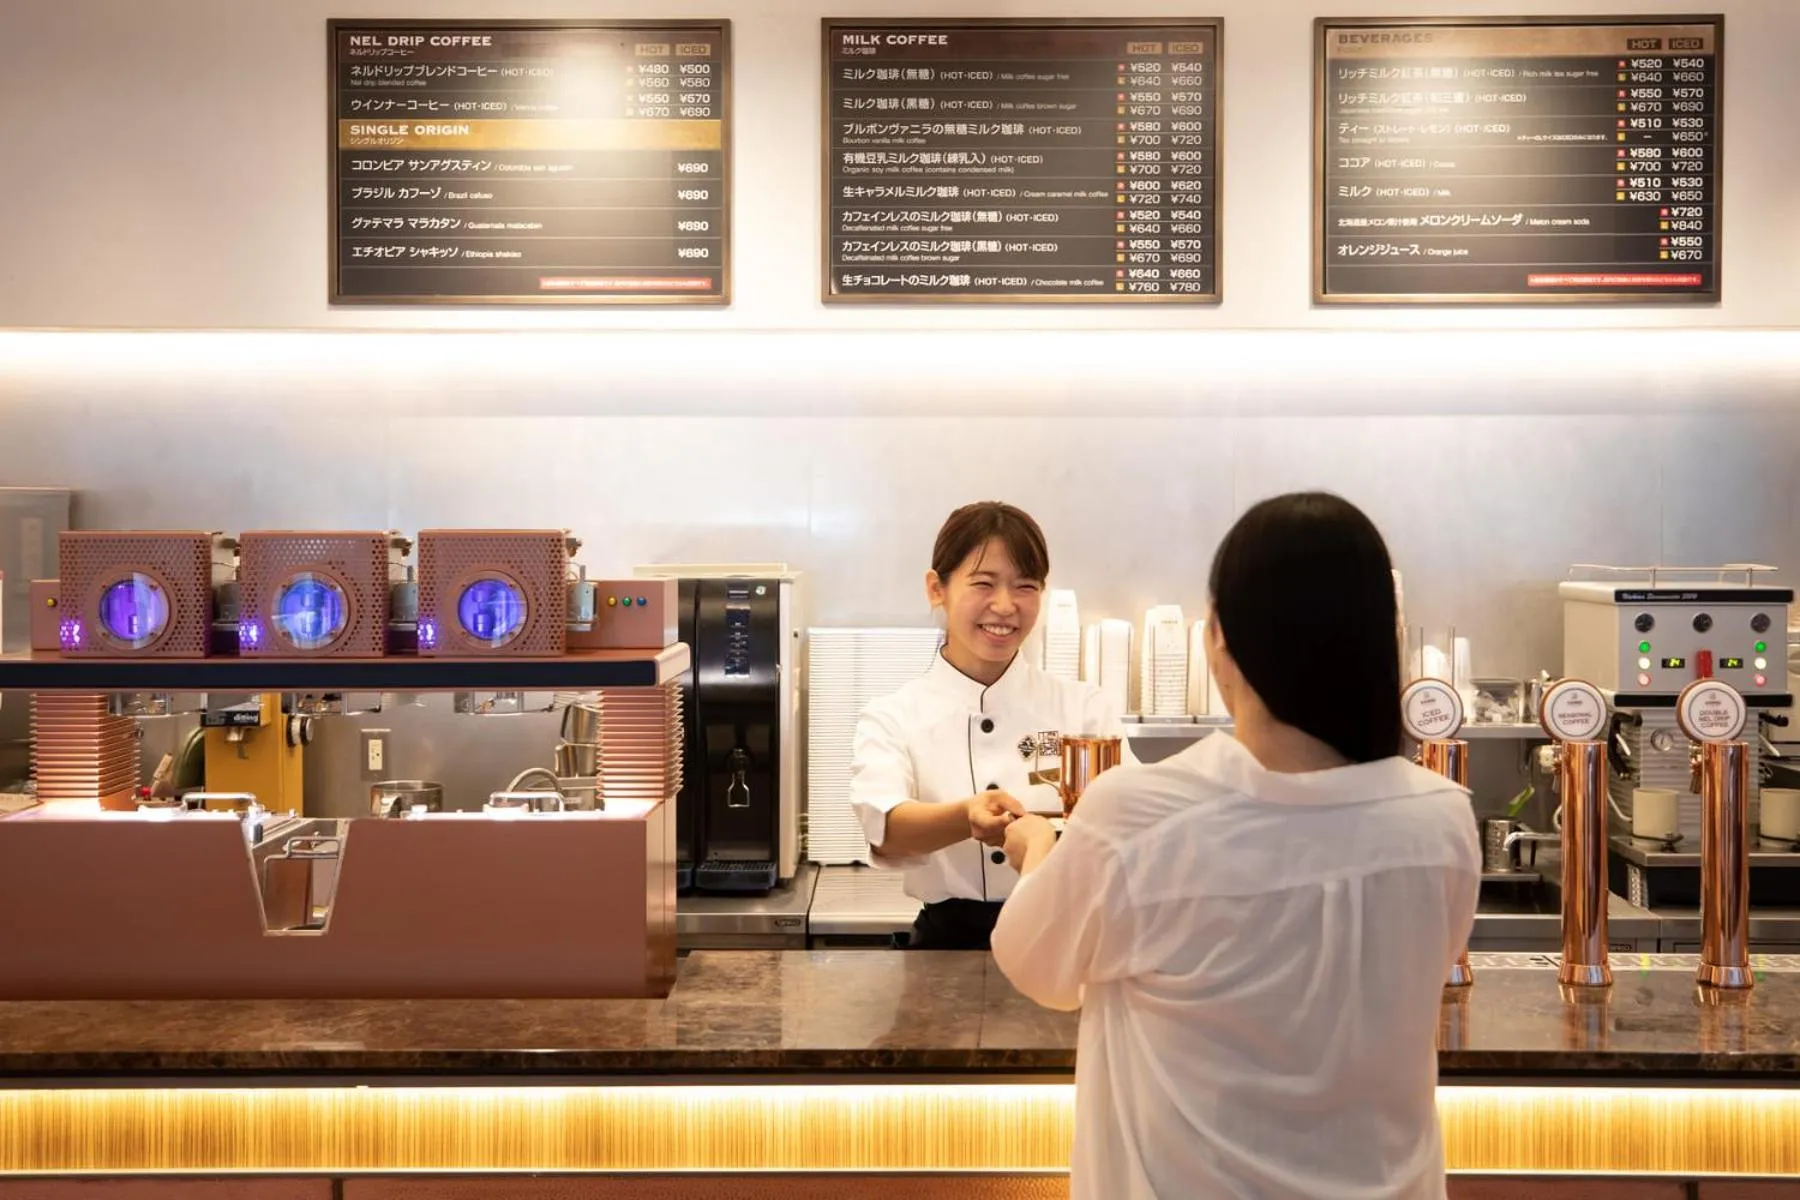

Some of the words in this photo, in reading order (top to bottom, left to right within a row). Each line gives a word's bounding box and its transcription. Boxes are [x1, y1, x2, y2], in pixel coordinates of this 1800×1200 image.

[350, 36, 381, 46] NEL
[388, 36, 425, 46] DRIP
[430, 36, 492, 46] COFFEE
[843, 35, 880, 45] MILK
[886, 35, 948, 45] COFFEE
[1339, 33, 1433, 44] BEVERAGES
[1632, 40, 1657, 48] HOT
[1672, 40, 1700, 48] ICED
[639, 64, 669, 73] ¥480
[680, 64, 710, 73] ¥500
[1130, 63, 1160, 72] ¥520
[1171, 63, 1202, 72] ¥540
[1631, 59, 1662, 68] ¥520
[1673, 59, 1704, 68] ¥540
[351, 65, 498, 77] ネルドリップブレンドコーヒー
[1130, 77, 1160, 85] ¥640
[1171, 77, 1202, 85] ¥660
[1631, 72, 1662, 82] ¥640
[1673, 72, 1704, 82] ¥660
[680, 78, 710, 87] ¥580
[1130, 92, 1160, 101] ¥550
[1171, 92, 1202, 101] ¥570
[1631, 88, 1662, 98] ¥550
[1673, 88, 1704, 98] ¥570
[639, 94, 669, 103] ¥550
[680, 94, 710, 103] ¥570
[351, 100, 449, 111] ウインナーコーヒー
[1130, 106, 1160, 115] ¥670
[1171, 106, 1202, 115] ¥690
[1630, 102, 1662, 112] ¥670
[1673, 102, 1704, 112] ¥690
[680, 107, 710, 116] ¥690
[1130, 122, 1160, 131] ¥580
[1171, 122, 1202, 131] ¥600
[1338, 122, 1368, 134] ティー
[1630, 118, 1662, 128] ¥510
[1672, 118, 1704, 128] ¥530
[350, 125, 408, 136] SINGLE
[415, 125, 469, 136] ORIGIN
[1130, 135, 1160, 144] ¥700
[1171, 135, 1202, 144] ¥720
[1130, 151, 1160, 160] ¥580
[1171, 151, 1202, 160] ¥600
[1630, 148, 1661, 158] ¥580
[1672, 148, 1703, 158] ¥600
[352, 160, 404, 171] コロンビア
[409, 160, 492, 171] サンアグスティン
[1339, 157, 1371, 168] ココア
[1630, 162, 1661, 171] ¥700
[1672, 162, 1703, 171] ¥720
[678, 163, 708, 173] ¥690
[1130, 165, 1160, 174] ¥700
[1171, 165, 1202, 174] ¥720
[1130, 181, 1160, 190] ¥600
[1171, 181, 1202, 190] ¥620
[1630, 178, 1661, 188] ¥510
[1672, 178, 1703, 188] ¥530
[352, 187, 395, 199] ブラジル
[678, 190, 708, 200] ¥690
[843, 186, 959, 197] 生キャラメルミルク珈琲
[1339, 186, 1372, 197] ミルク
[1630, 191, 1661, 201] ¥630
[1672, 191, 1703, 201] ¥650
[1130, 194, 1160, 203] ¥720
[1171, 194, 1201, 203] ¥740
[1129, 210, 1160, 220] ¥520
[1171, 210, 1201, 220] ¥540
[1671, 207, 1703, 217] ¥720
[352, 217, 403, 229] グァテマラ
[408, 218, 461, 229] マラカタン
[1419, 213, 1523, 226] メロンクリームソーダ
[678, 221, 708, 231] ¥690
[1129, 224, 1160, 233] ¥640
[1171, 224, 1201, 233] ¥660
[1671, 221, 1703, 230] ¥840
[1129, 240, 1160, 249] ¥550
[1170, 240, 1201, 249] ¥570
[1671, 237, 1703, 247] ¥550
[352, 247, 405, 258] エチオピア
[409, 247, 459, 258] シャキッソ
[678, 248, 708, 258] ¥690
[1338, 244, 1420, 256] オレンジジュース
[1671, 250, 1703, 260] ¥670
[1129, 253, 1160, 262] ¥670
[1170, 253, 1201, 262] ¥690
[1129, 269, 1160, 278] ¥640
[1170, 269, 1200, 278] ¥660
[842, 275, 970, 286] 生チョコレートのミルク珈琲
[1129, 282, 1160, 291] ¥760
[1170, 282, 1200, 291] ¥780
[1422, 708, 1442, 718] ICED
[1417, 714, 1449, 726] COFFEE
